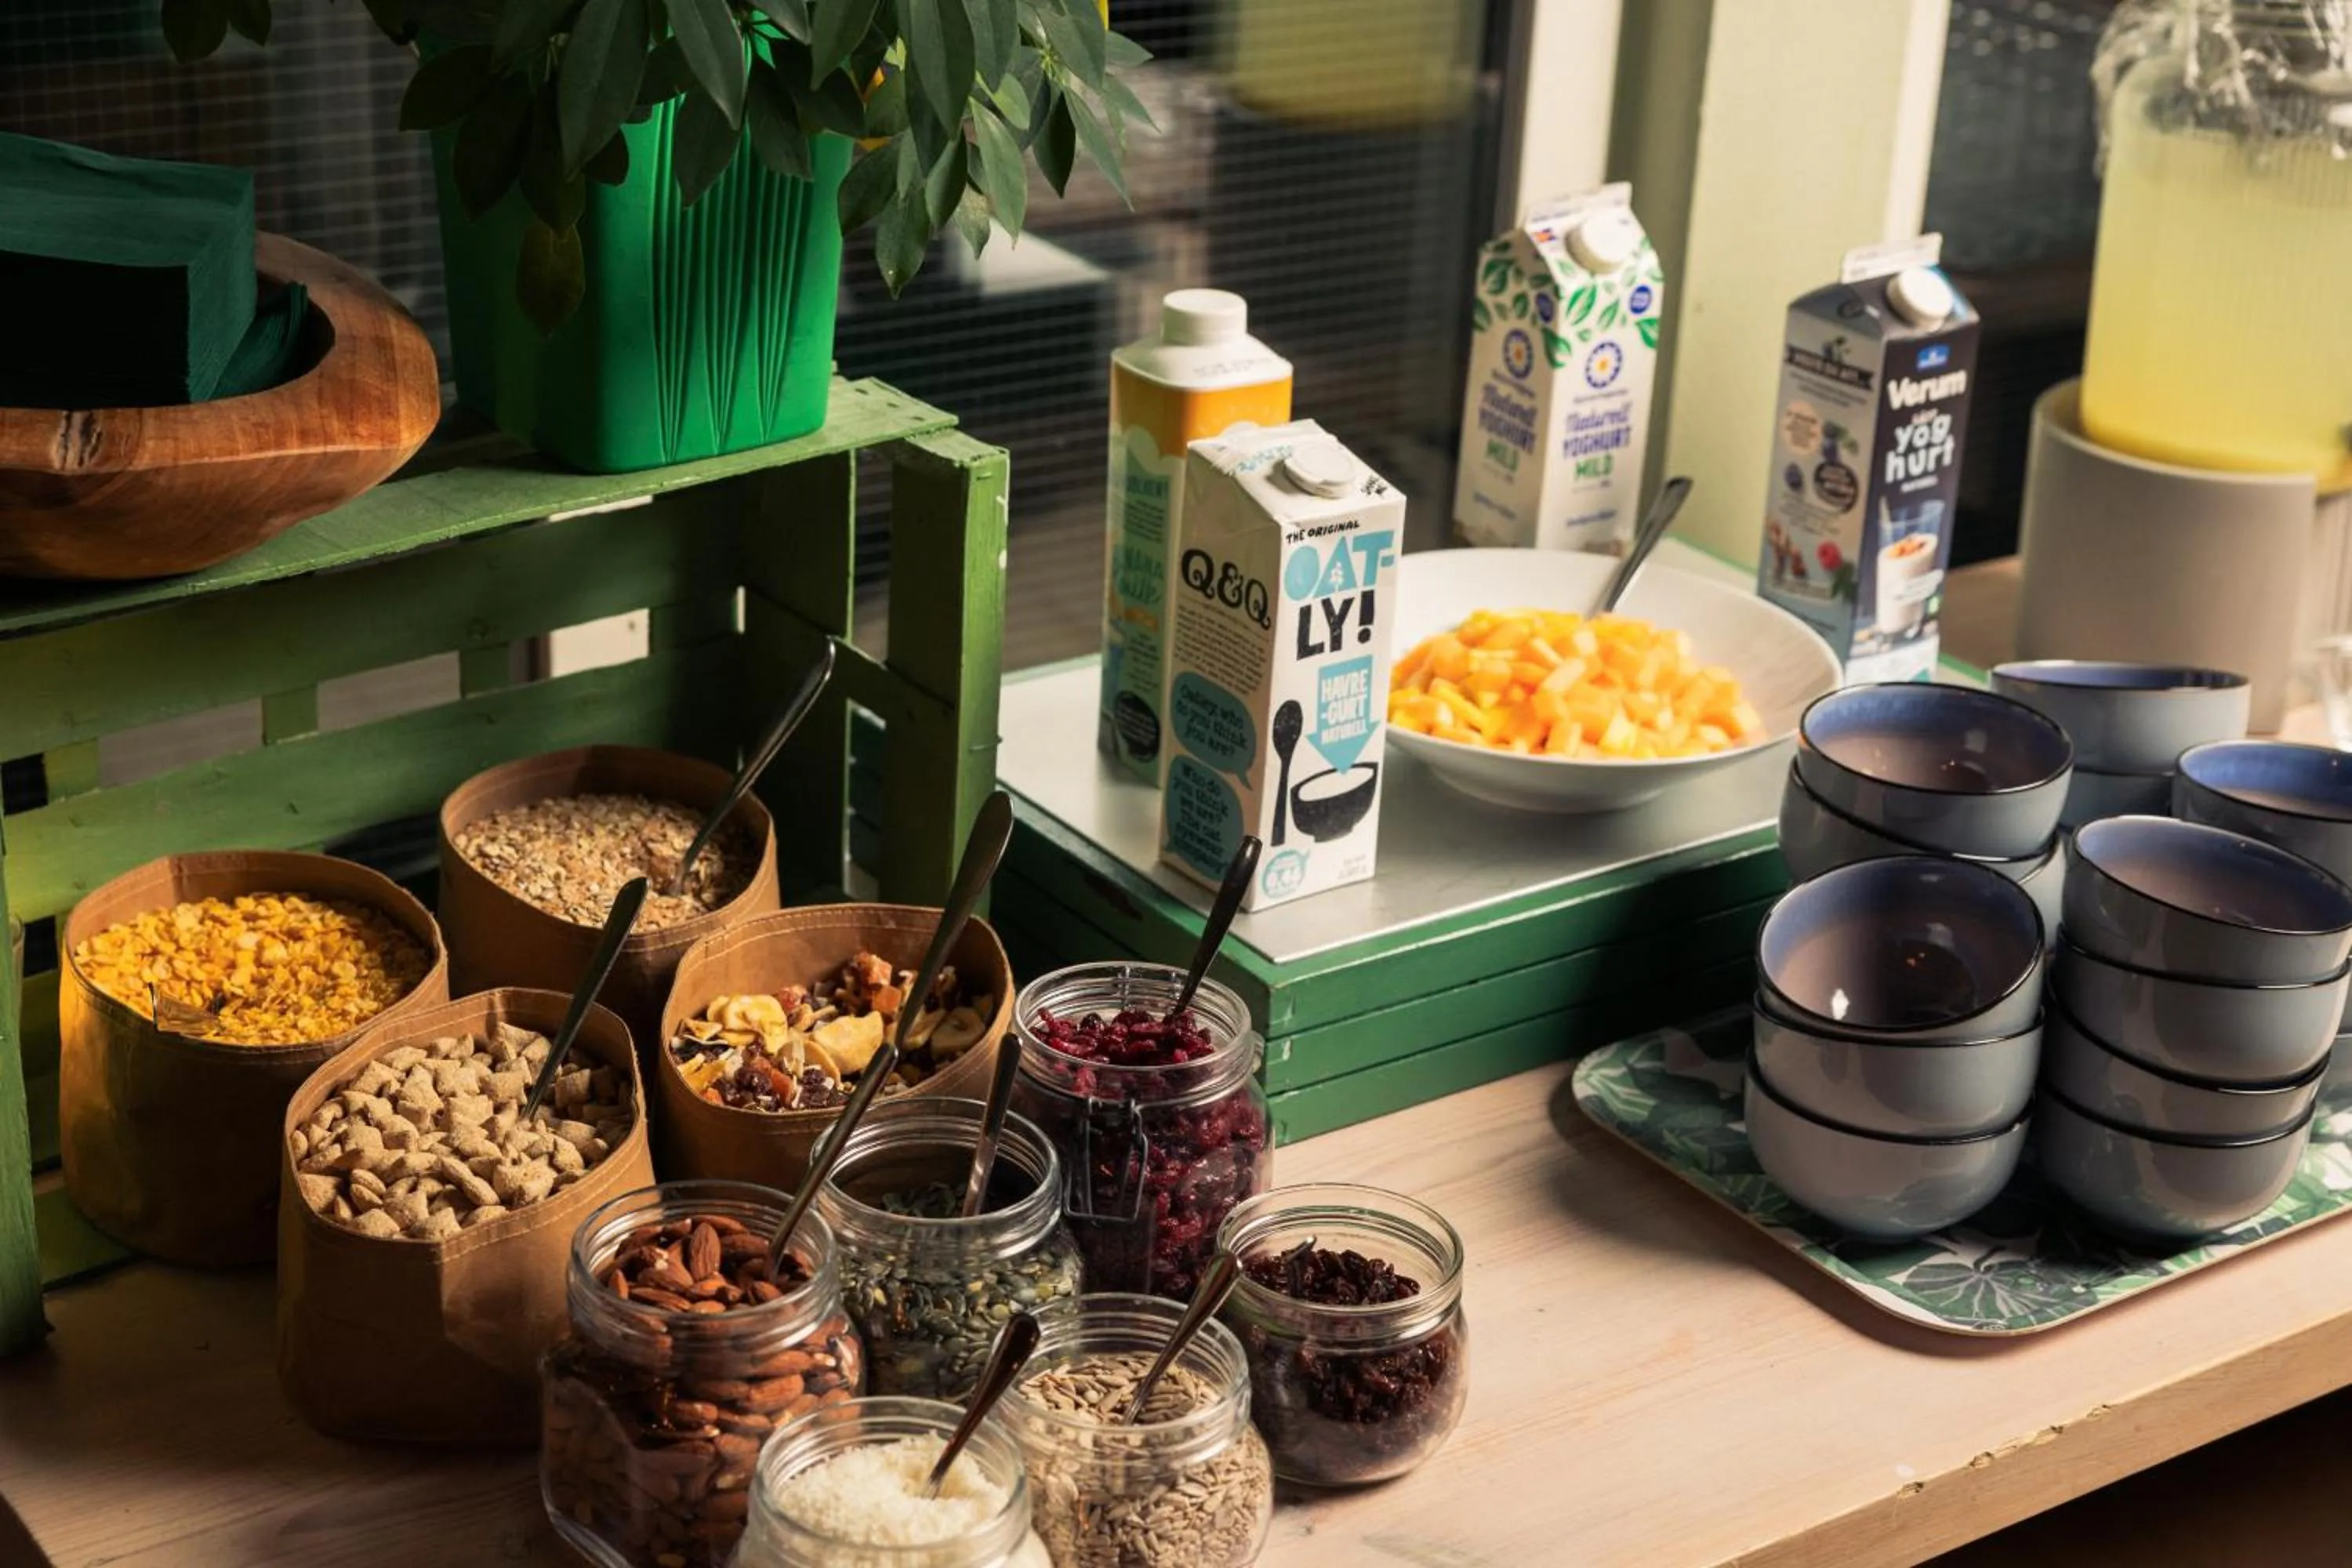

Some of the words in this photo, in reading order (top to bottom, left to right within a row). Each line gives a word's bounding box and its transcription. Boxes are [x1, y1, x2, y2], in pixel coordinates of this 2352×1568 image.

[1888, 369, 1967, 410] Verum
[1894, 414, 1952, 454] yog
[1886, 434, 1955, 484] hurt
[1286, 529, 1305, 545] THE
[1307, 520, 1360, 537] ORIGINAL
[1284, 530, 1395, 601] OAT-
[1181, 549, 1271, 630] Q&Q
[1296, 590, 1374, 661] LY!
[1321, 668, 1368, 702] HAVRE
